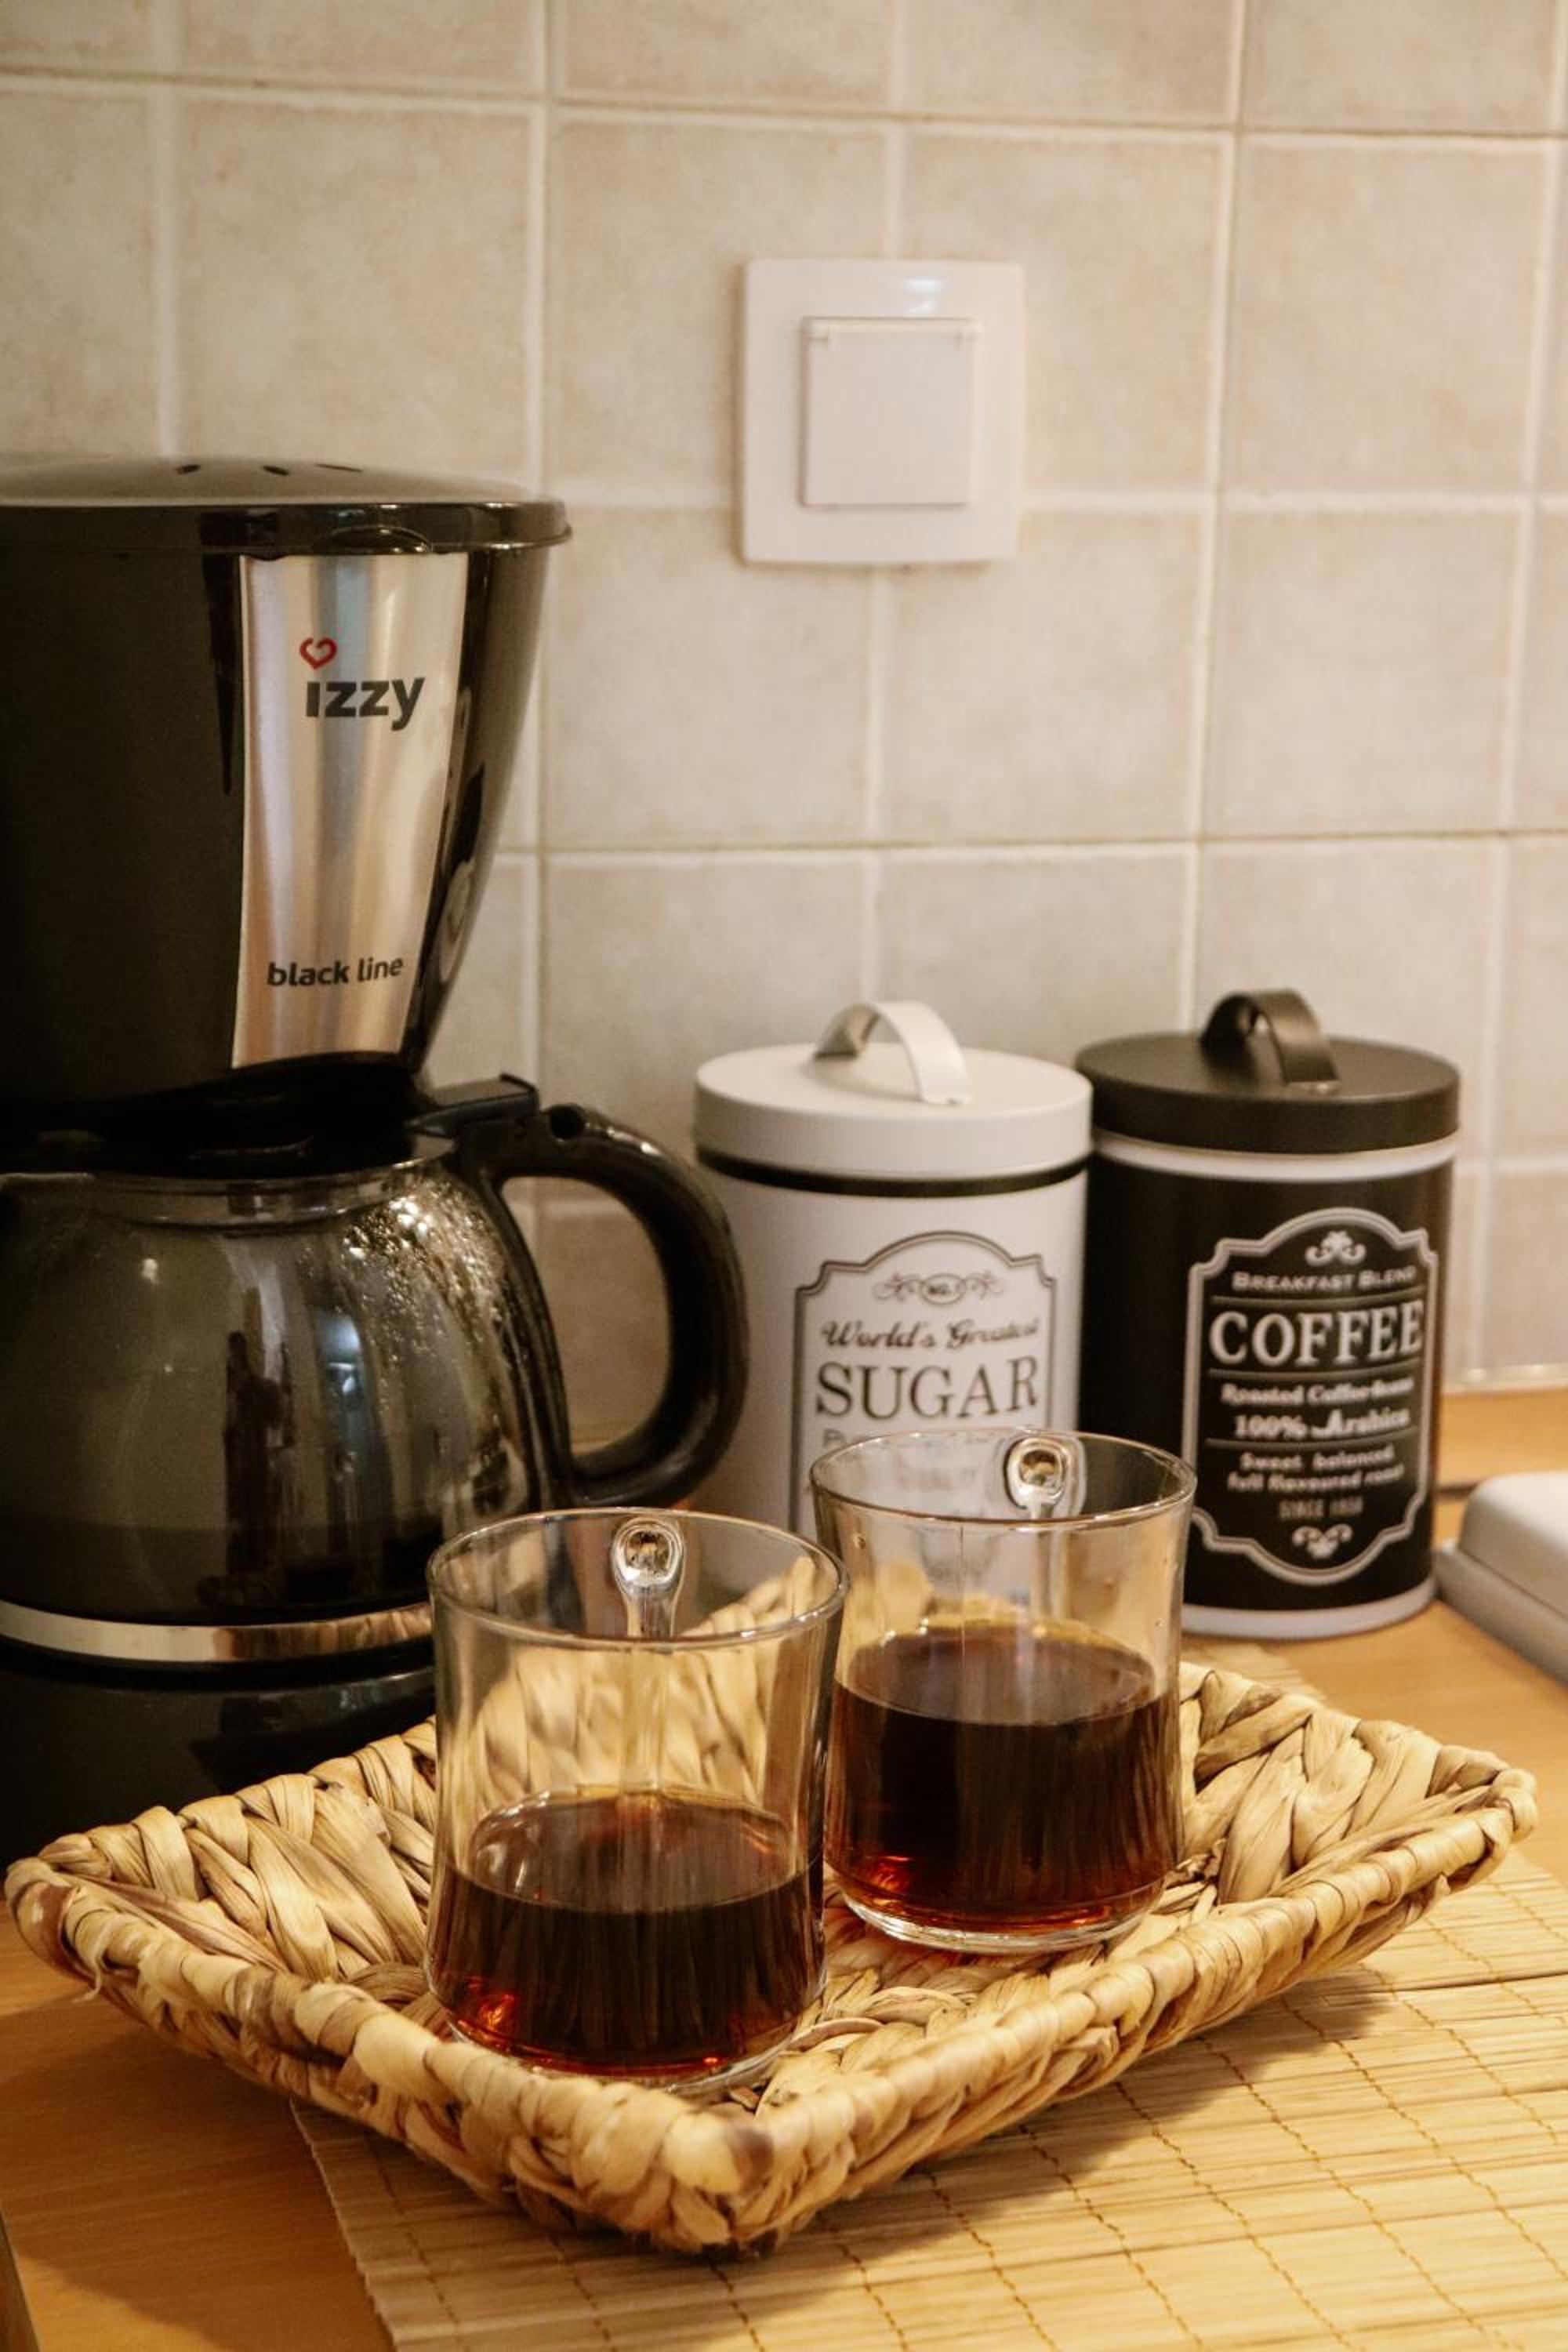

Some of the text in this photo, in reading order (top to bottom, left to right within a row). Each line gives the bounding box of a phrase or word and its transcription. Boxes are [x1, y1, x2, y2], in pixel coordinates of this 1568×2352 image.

[306, 677, 426, 731] izzy
[267, 957, 405, 986] black line
[1232, 1265, 1417, 1292] BREAKFAST BLEND
[821, 1319, 938, 1349] World's
[1210, 1299, 1425, 1367] COFFEE
[815, 1355, 1040, 1420] SUGAR
[1235, 1414, 1308, 1441] 100%
